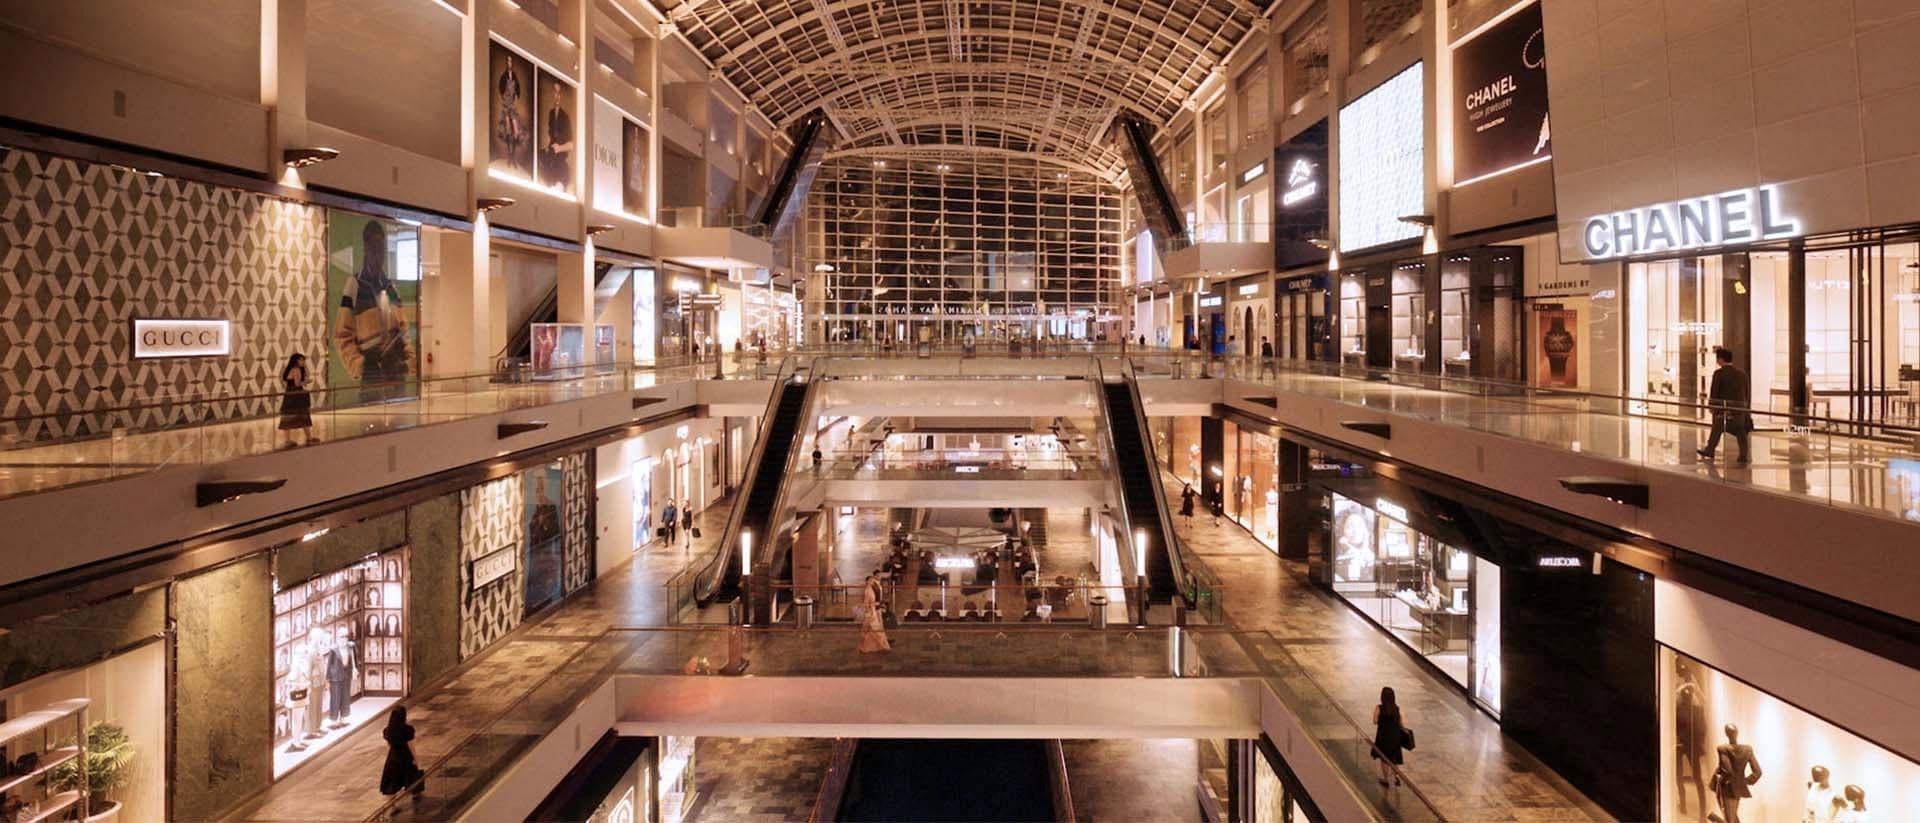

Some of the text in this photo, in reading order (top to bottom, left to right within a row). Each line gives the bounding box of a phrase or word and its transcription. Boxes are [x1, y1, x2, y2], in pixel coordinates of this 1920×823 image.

[1466, 75, 1517, 110] CHANEL
[1585, 189, 1794, 257] CHANEL
[1544, 281, 1577, 290] GARDENS
[143, 330, 219, 347] GUCCI
[477, 552, 512, 579] GUCCI
